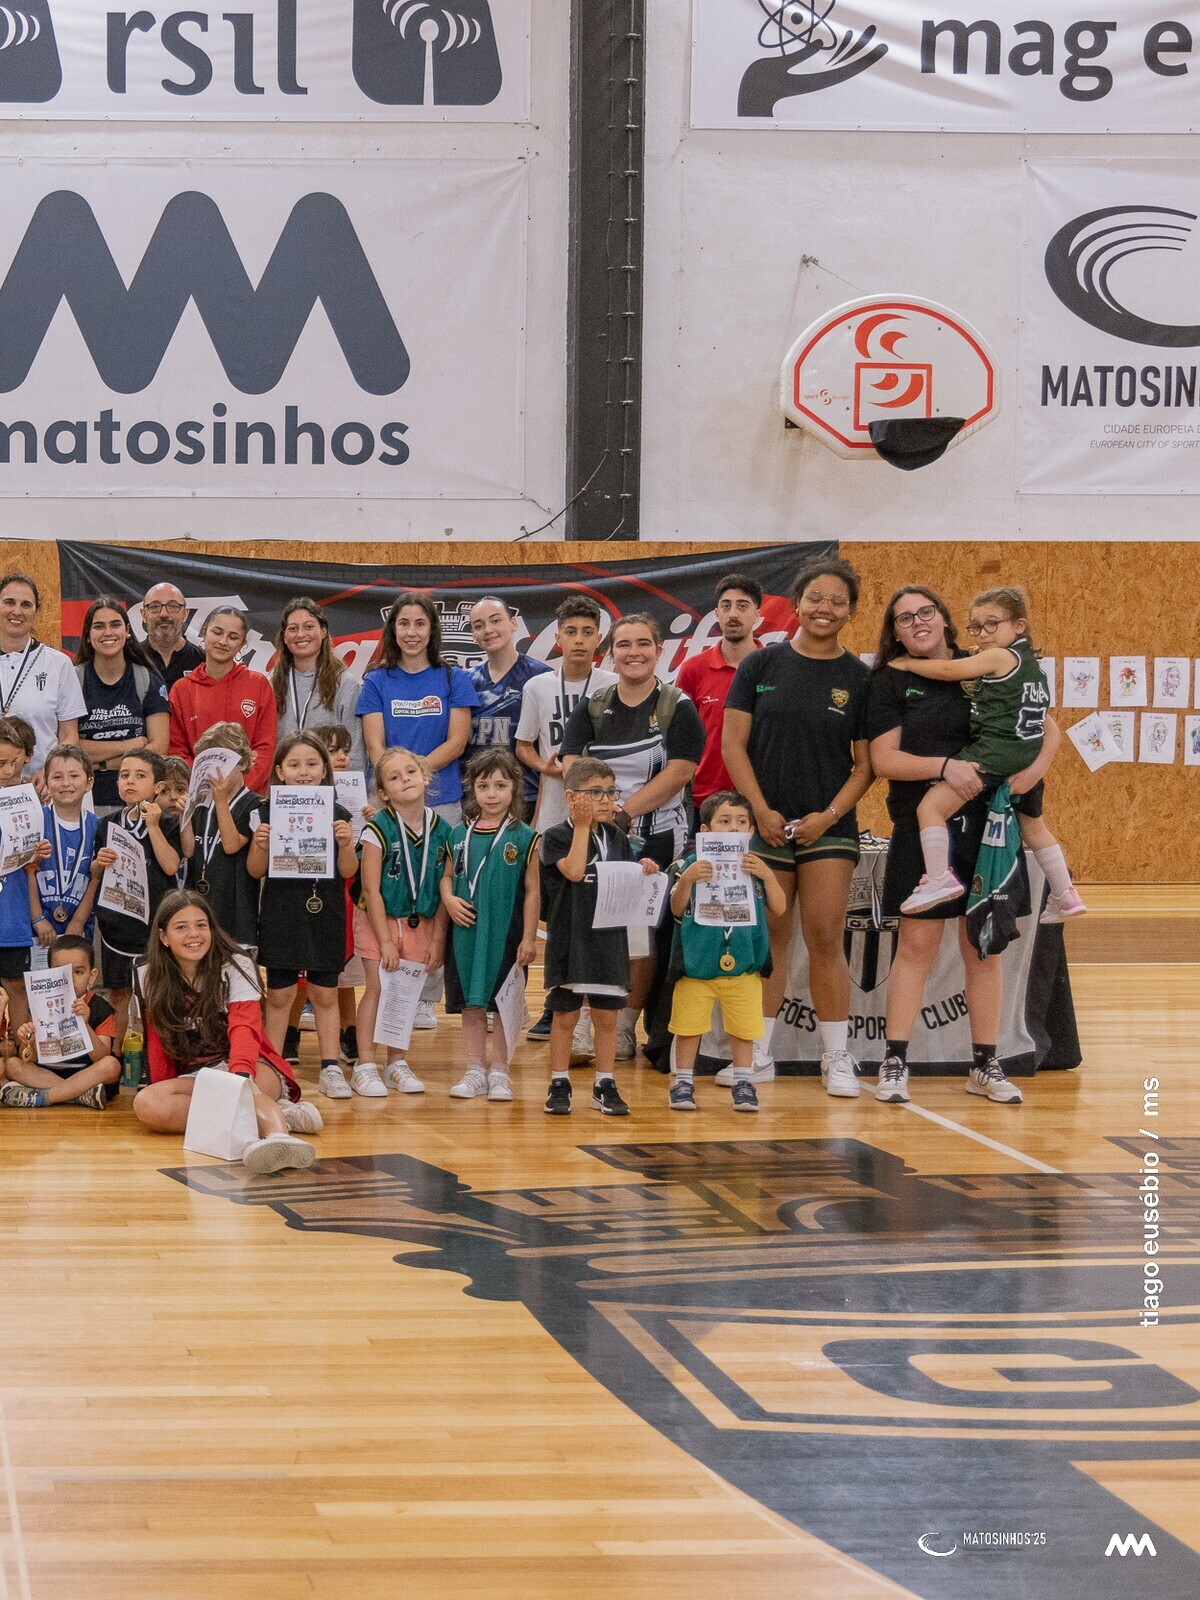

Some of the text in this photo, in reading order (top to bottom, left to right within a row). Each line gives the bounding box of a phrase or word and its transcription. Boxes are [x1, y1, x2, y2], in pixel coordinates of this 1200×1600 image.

[920, 19, 1118, 102] mag
[1040, 364, 1200, 408] MATOSIN
[1103, 424, 1141, 434] CIDADE
[1143, 424, 1194, 434] EUROPEIA
[1089, 440, 1200, 449] EUROPEAN CITY OF SPORT
[92, 728, 130, 740] CPN
[920, 989, 969, 1030] CLUB
